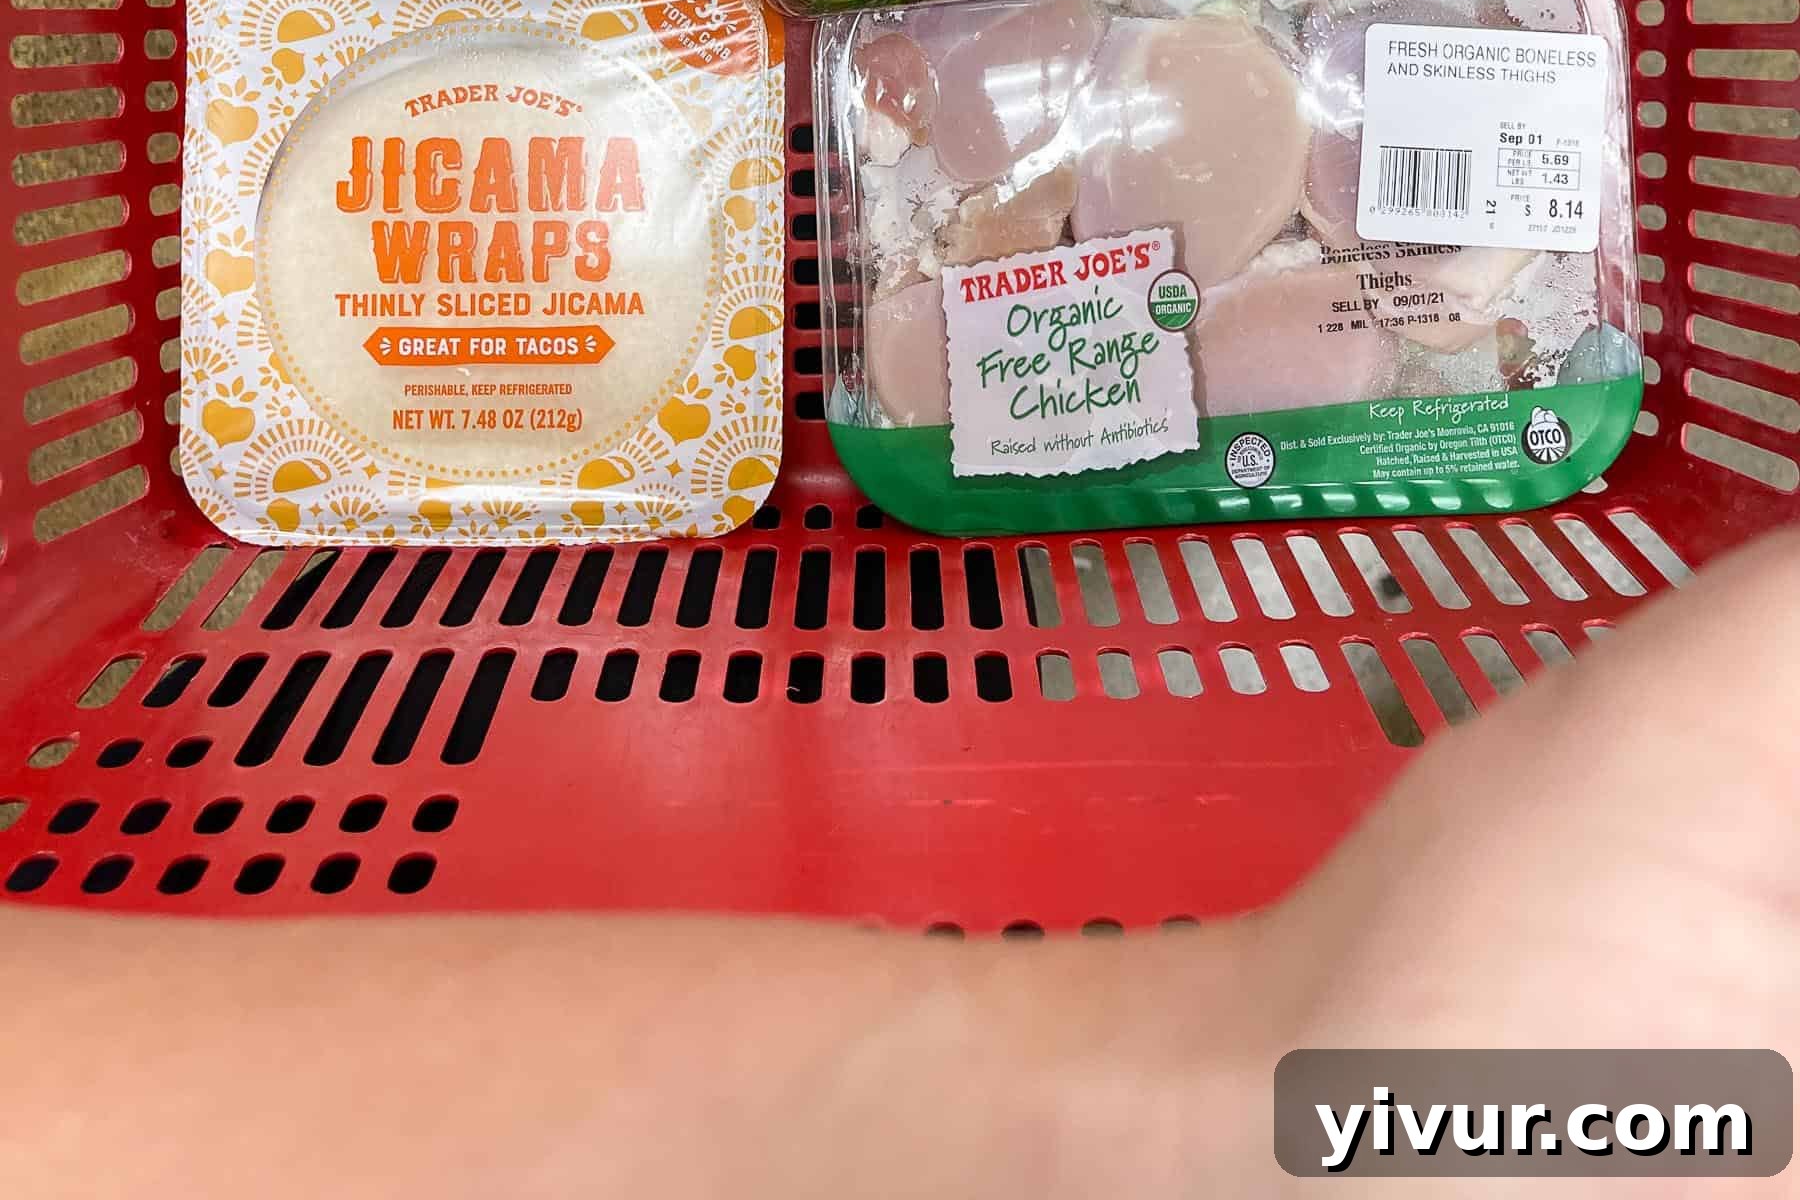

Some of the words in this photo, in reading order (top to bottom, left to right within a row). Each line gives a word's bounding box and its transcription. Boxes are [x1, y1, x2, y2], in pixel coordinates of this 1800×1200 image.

[662, 2, 696, 36] TOTAL
[1388, 41, 1438, 58] FRESH
[1442, 43, 1511, 63] ORGANIC
[1515, 48, 1597, 68] BONELESS
[1387, 63, 1419, 77] AND
[1423, 64, 1496, 81] SKINLESS
[1500, 68, 1556, 85] THIGHS
[404, 84, 500, 118] TRADER
[505, 85, 577, 117] JOE'S
[1499, 132, 1523, 146] Sep
[1528, 134, 1542, 145] 01
[1541, 153, 1569, 166] 5.69
[336, 136, 645, 213] JICAMA
[1541, 173, 1569, 185] 1.43
[1485, 199, 1497, 215] 21
[1549, 198, 1584, 220] 8.14
[372, 220, 612, 284] WRAPS
[960, 259, 1066, 304] TRADER
[1158, 285, 1188, 299] USDA
[1356, 271, 1413, 292] Thighs
[334, 293, 426, 318] THINLY
[437, 293, 531, 316] SLICED
[542, 292, 645, 315] JICAMA
[1155, 302, 1193, 316] ORGANIC
[1332, 301, 1361, 313] SELL
[1364, 298, 1380, 310] BY
[1393, 292, 1445, 308] 09/01/21
[1007, 285, 1124, 352] Organic
[1318, 324, 1323, 333] 1
[1326, 323, 1344, 333] 228
[1351, 320, 1369, 330] MIL
[398, 337, 460, 356] GREAT
[470, 337, 507, 355] FOR
[516, 337, 579, 355] TACOS
[976, 349, 1050, 389] Free
[1068, 332, 1160, 379] Range
[405, 384, 468, 397] PERISHABLE,
[471, 384, 497, 396] KEEP
[499, 383, 572, 396] REFRIGERATED
[1009, 378, 1141, 420] Chicken
[393, 409, 424, 430] NET
[429, 409, 455, 430] WT.
[461, 409, 497, 429] 7.48
[502, 409, 524, 429] OZ
[530, 408, 583, 432] (212g)
[1369, 402, 1405, 426] Keep
[1413, 393, 1510, 424] Refrigerated
[991, 436, 1036, 456] Raised
[1044, 429, 1094, 452] without
[1100, 415, 1169, 445] Antibiotics
[1300, 439, 1306, 448] &
[1308, 436, 1326, 448] Sold
[1327, 432, 1372, 445] Exclusively
[1388, 429, 1412, 441] Trader
[1414, 428, 1436, 439] Joe's
[1477, 424, 1489, 433] CA
[1490, 421, 1515, 432] 91016
[1360, 443, 1394, 455] Certified
[1395, 441, 1427, 454] Organic
[1428, 441, 1438, 452] by
[1439, 439, 1468, 450] Oregon
[1489, 433, 1517, 446] (OTCO)
[1529, 428, 1562, 446] OTCO
[1229, 436, 1271, 461] INSPECTED
[1413, 453, 1440, 464] Raised
[1441, 453, 1449, 462] &
[1449, 449, 1490, 461] Harvested
[1491, 448, 1500, 457] in
[1500, 445, 1518, 456] USA
[1373, 468, 1390, 480] May
[1391, 467, 1422, 478] contain
[1423, 468, 1434, 478] up
[1435, 465, 1444, 474] to
[1445, 464, 1458, 474] 5%
[1460, 461, 1494, 473] retained
